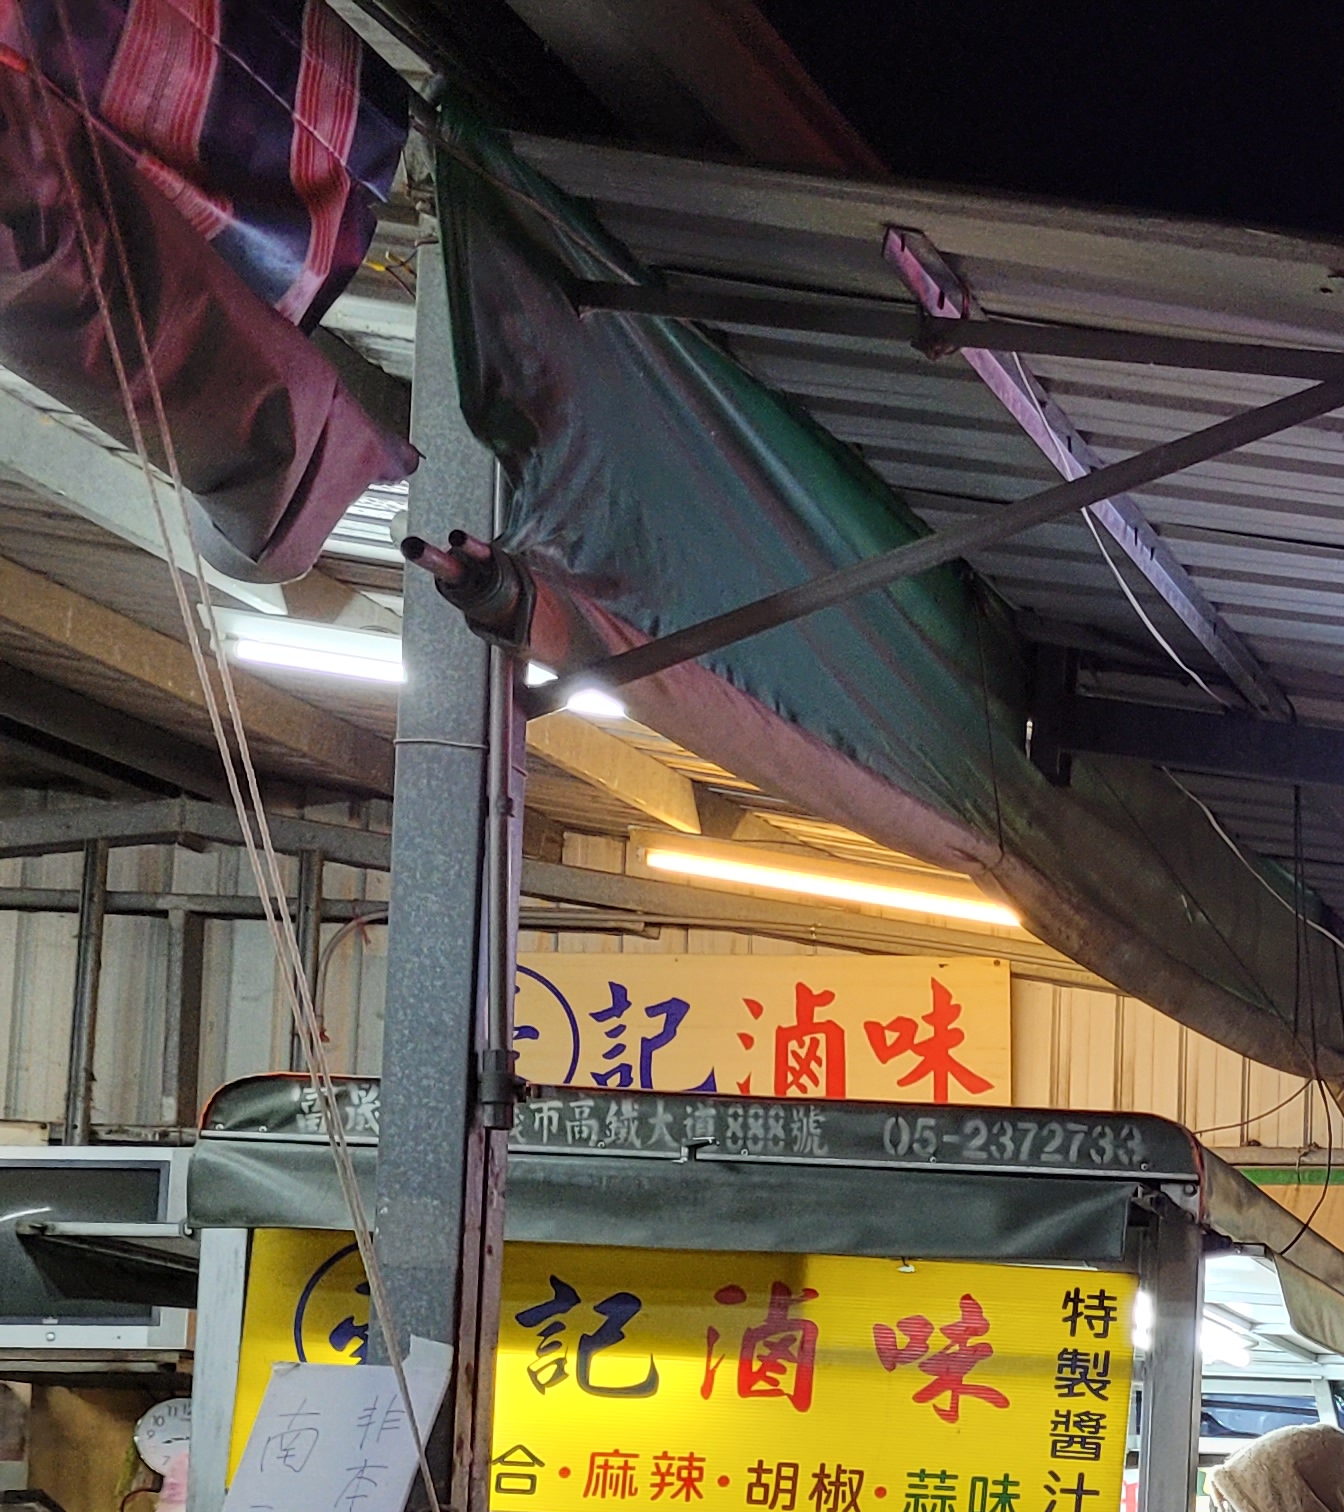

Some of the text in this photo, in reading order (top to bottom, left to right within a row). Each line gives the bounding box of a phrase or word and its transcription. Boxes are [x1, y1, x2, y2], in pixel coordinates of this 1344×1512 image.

[513, 976, 996, 1101] 記滷味
[884, 1115, 1148, 1167] 05-2372733
